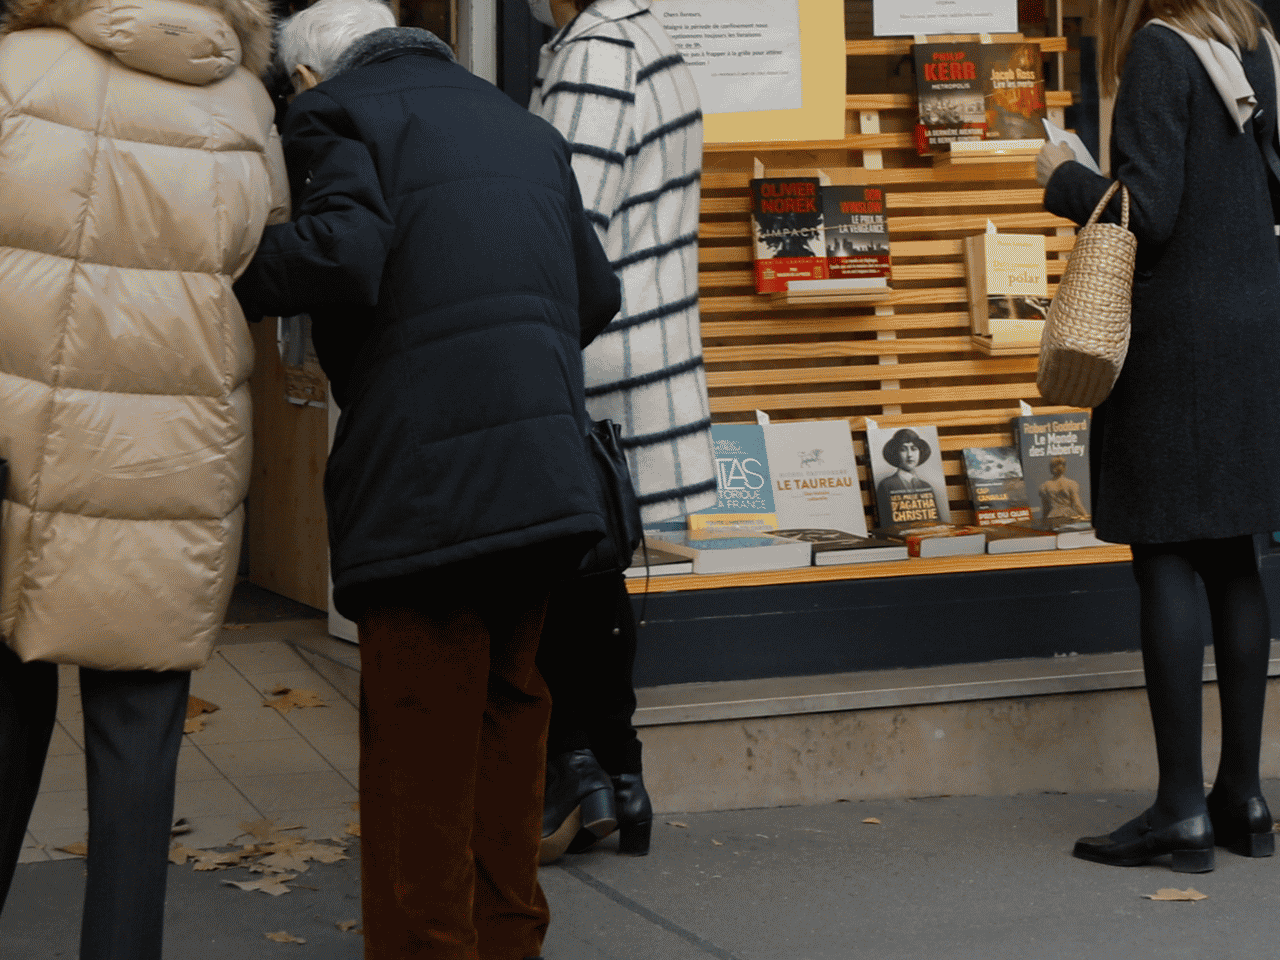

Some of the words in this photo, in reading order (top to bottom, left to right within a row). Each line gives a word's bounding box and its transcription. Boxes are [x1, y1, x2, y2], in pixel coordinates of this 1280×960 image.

[924, 62, 976, 81] KERR
[760, 182, 816, 197] OLIVIER
[761, 197, 818, 213] NOREK
[1008, 270, 1041, 287] polar
[1034, 434, 1046, 445] Le
[776, 479, 792, 491] LE
[793, 477, 853, 490] TAUREAU
[892, 508, 938, 522] CHRISTIE
